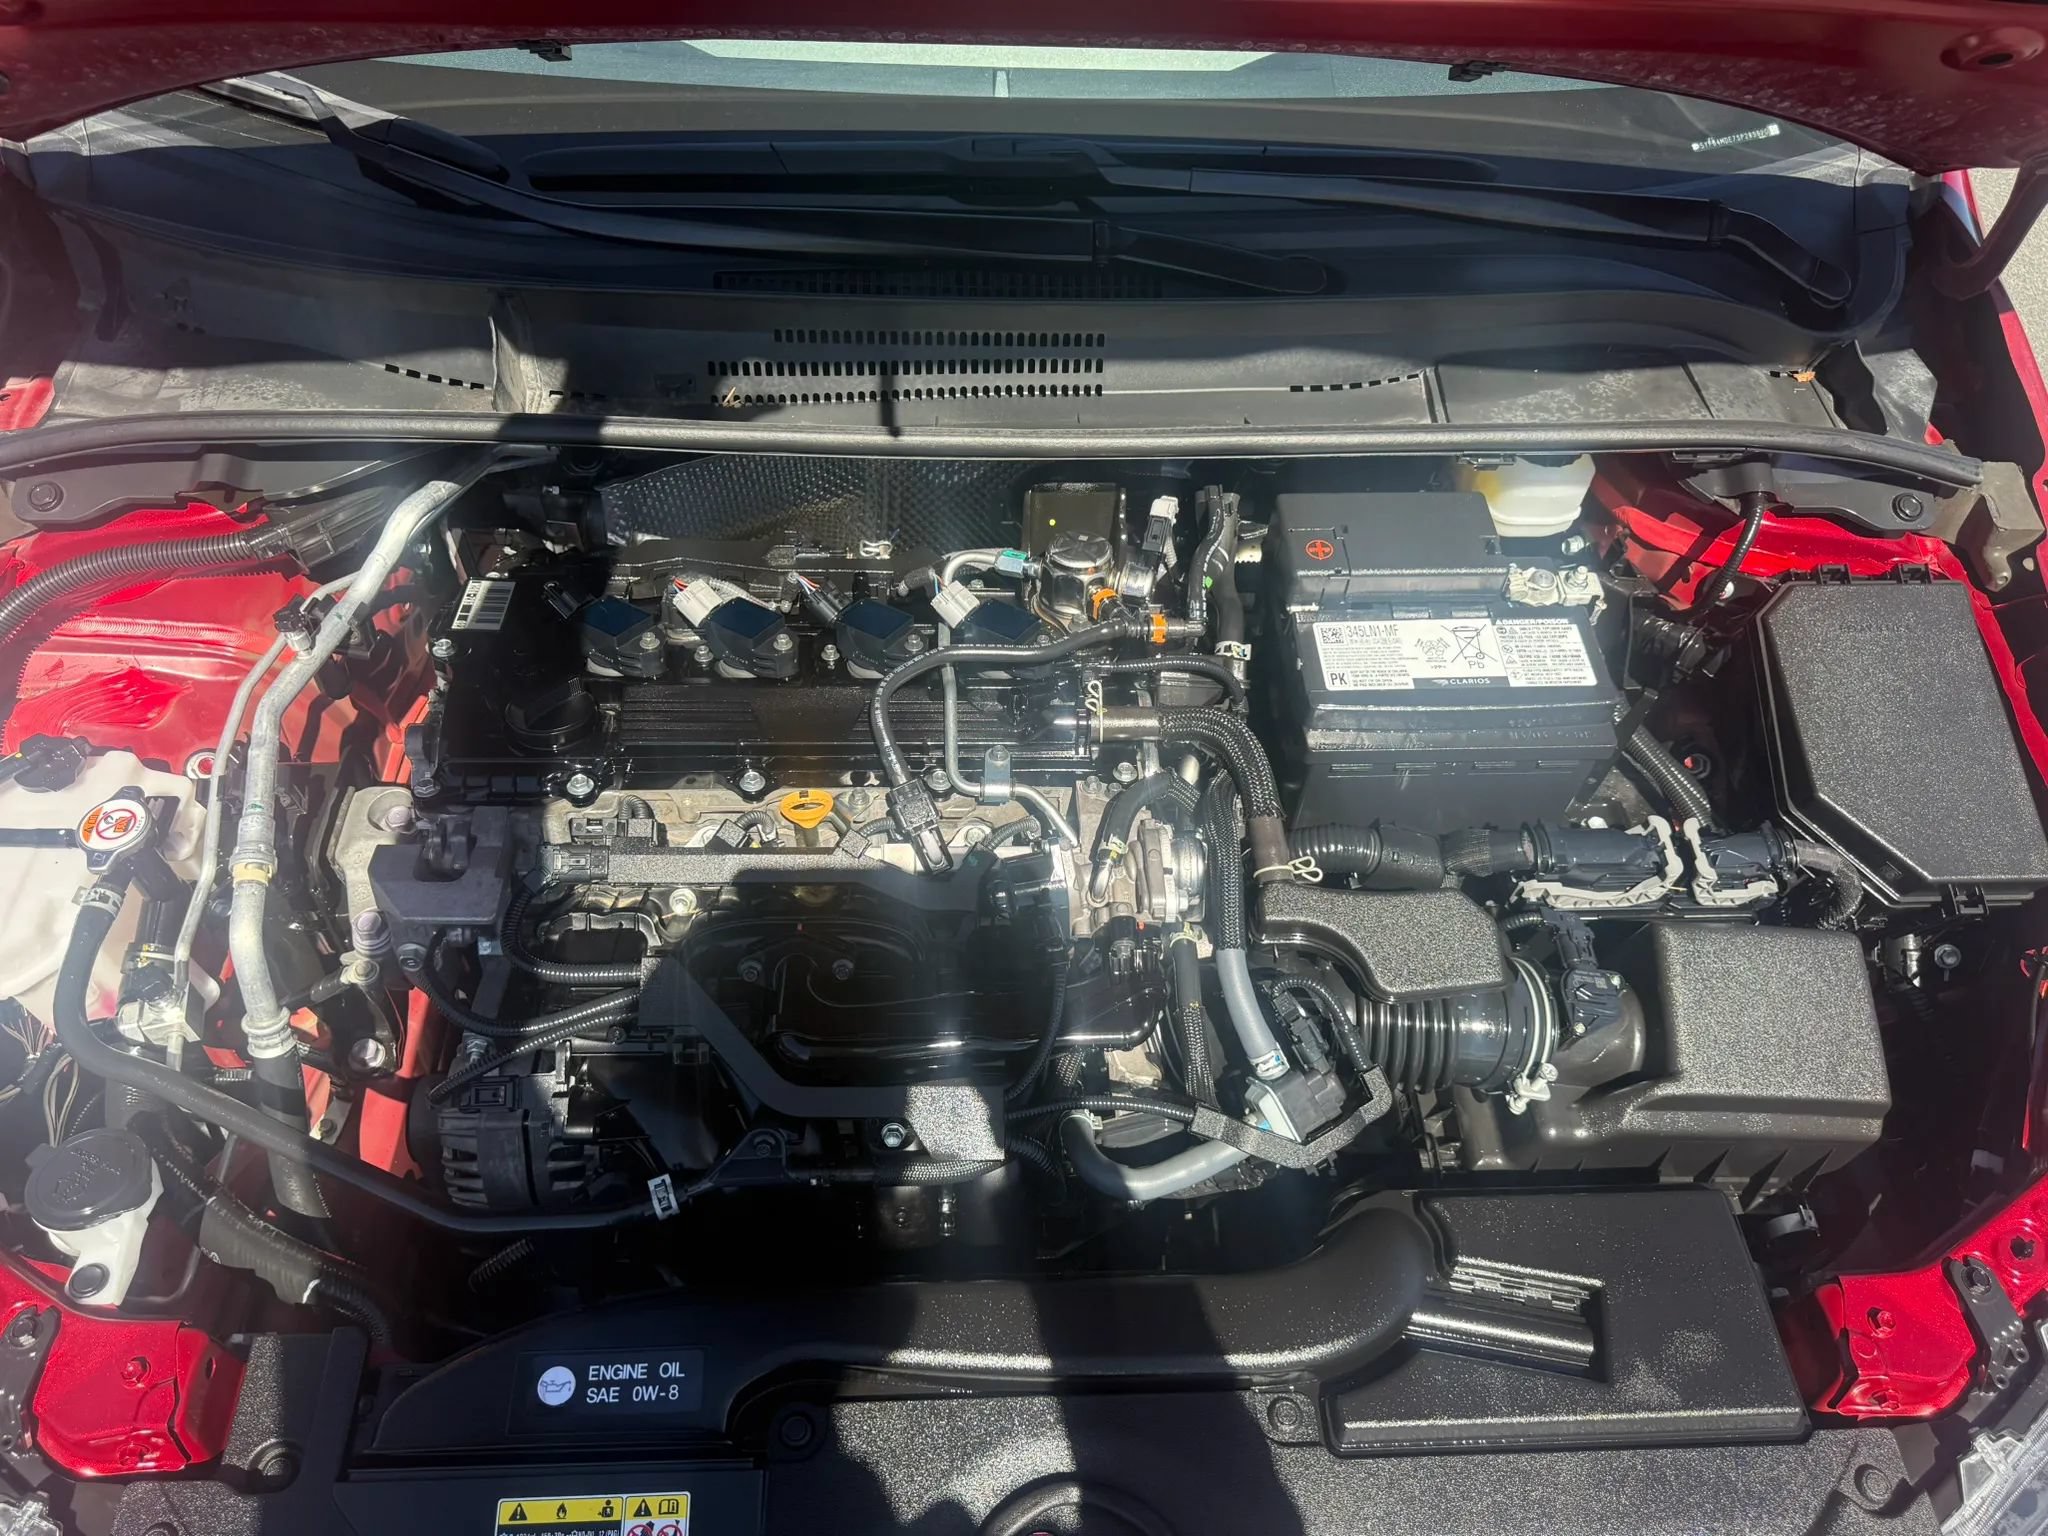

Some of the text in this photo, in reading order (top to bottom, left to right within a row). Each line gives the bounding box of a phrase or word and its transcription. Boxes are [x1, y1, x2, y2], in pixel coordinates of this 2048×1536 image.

[1346, 624, 1399, 637] 345LN1-MF
[1467, 660, 1485, 669] Pb
[1330, 672, 1348, 686] PK
[588, 1361, 686, 1381] ENGINE OIL
[586, 1384, 679, 1403] SAE 0W-8
